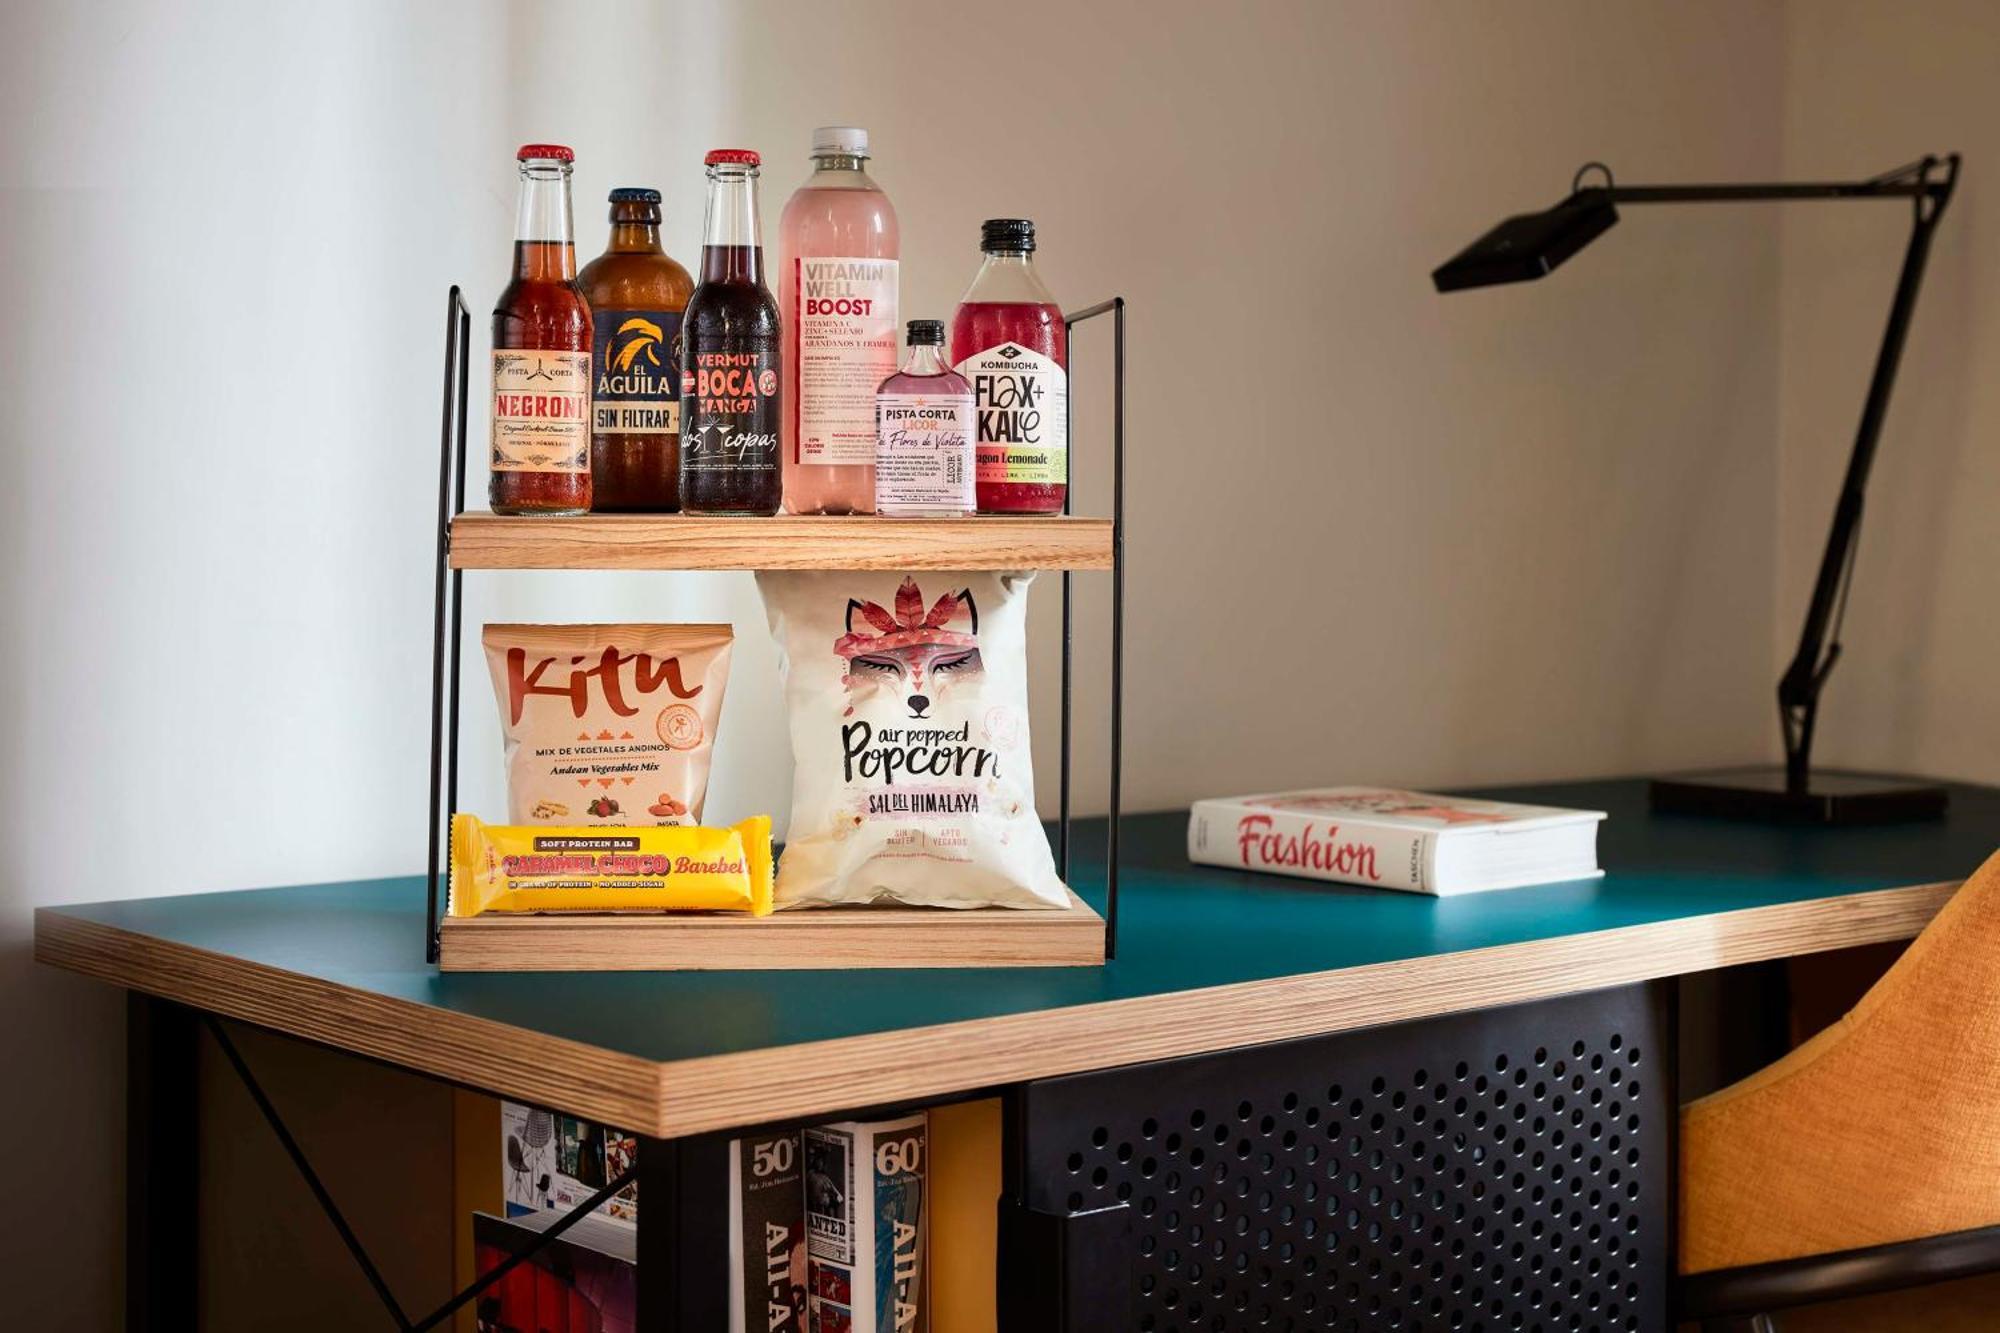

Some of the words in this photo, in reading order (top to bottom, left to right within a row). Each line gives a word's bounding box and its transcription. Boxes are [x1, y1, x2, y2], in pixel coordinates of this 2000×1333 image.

[805, 263, 884, 281] VITAMIN
[806, 281, 856, 298] WELL
[806, 298, 873, 316] BOOST
[696, 353, 760, 367] VERMUT
[980, 361, 1038, 370] KOMBUCHA
[634, 365, 647, 376] EL
[697, 369, 758, 397] BOCA
[497, 395, 585, 420] NEGRONI
[886, 409, 917, 420] PISTA
[918, 409, 957, 421] CORTA
[597, 409, 618, 429] SIN
[622, 409, 670, 429] FILTRAR
[902, 420, 938, 431] LICOR
[681, 416, 702, 453] dos
[724, 430, 777, 461] copas
[889, 429, 918, 451] Flores
[935, 432, 968, 451] Violeta
[976, 454, 1001, 465] agon
[1002, 452, 1048, 464] Lemonade
[946, 455, 955, 484] LICOR
[507, 645, 704, 727] Kitu
[878, 728, 905, 743] air
[906, 721, 969, 747] popped
[535, 748, 556, 756] MIX
[559, 747, 572, 756] DE
[573, 745, 626, 754] VEGETALES
[628, 743, 670, 752] ANDINOS
[842, 721, 1002, 785] Popcorn
[550, 766, 589, 776] Andean
[591, 762, 639, 775] Vegetables
[641, 762, 661, 771] Mix
[869, 794, 892, 814] SAL
[892, 793, 909, 811] DEL
[911, 793, 979, 814] HIMALAYA
[540, 840, 566, 848] SOFT
[568, 840, 612, 848] PROTEIN
[614, 840, 634, 848] BAR
[1236, 814, 1381, 882] Fashion
[502, 855, 598, 877] CARAMEL
[597, 854, 671, 877] CHOCO
[766, 1221, 792, 1333] All-A
[893, 1218, 918, 1333] All-A
